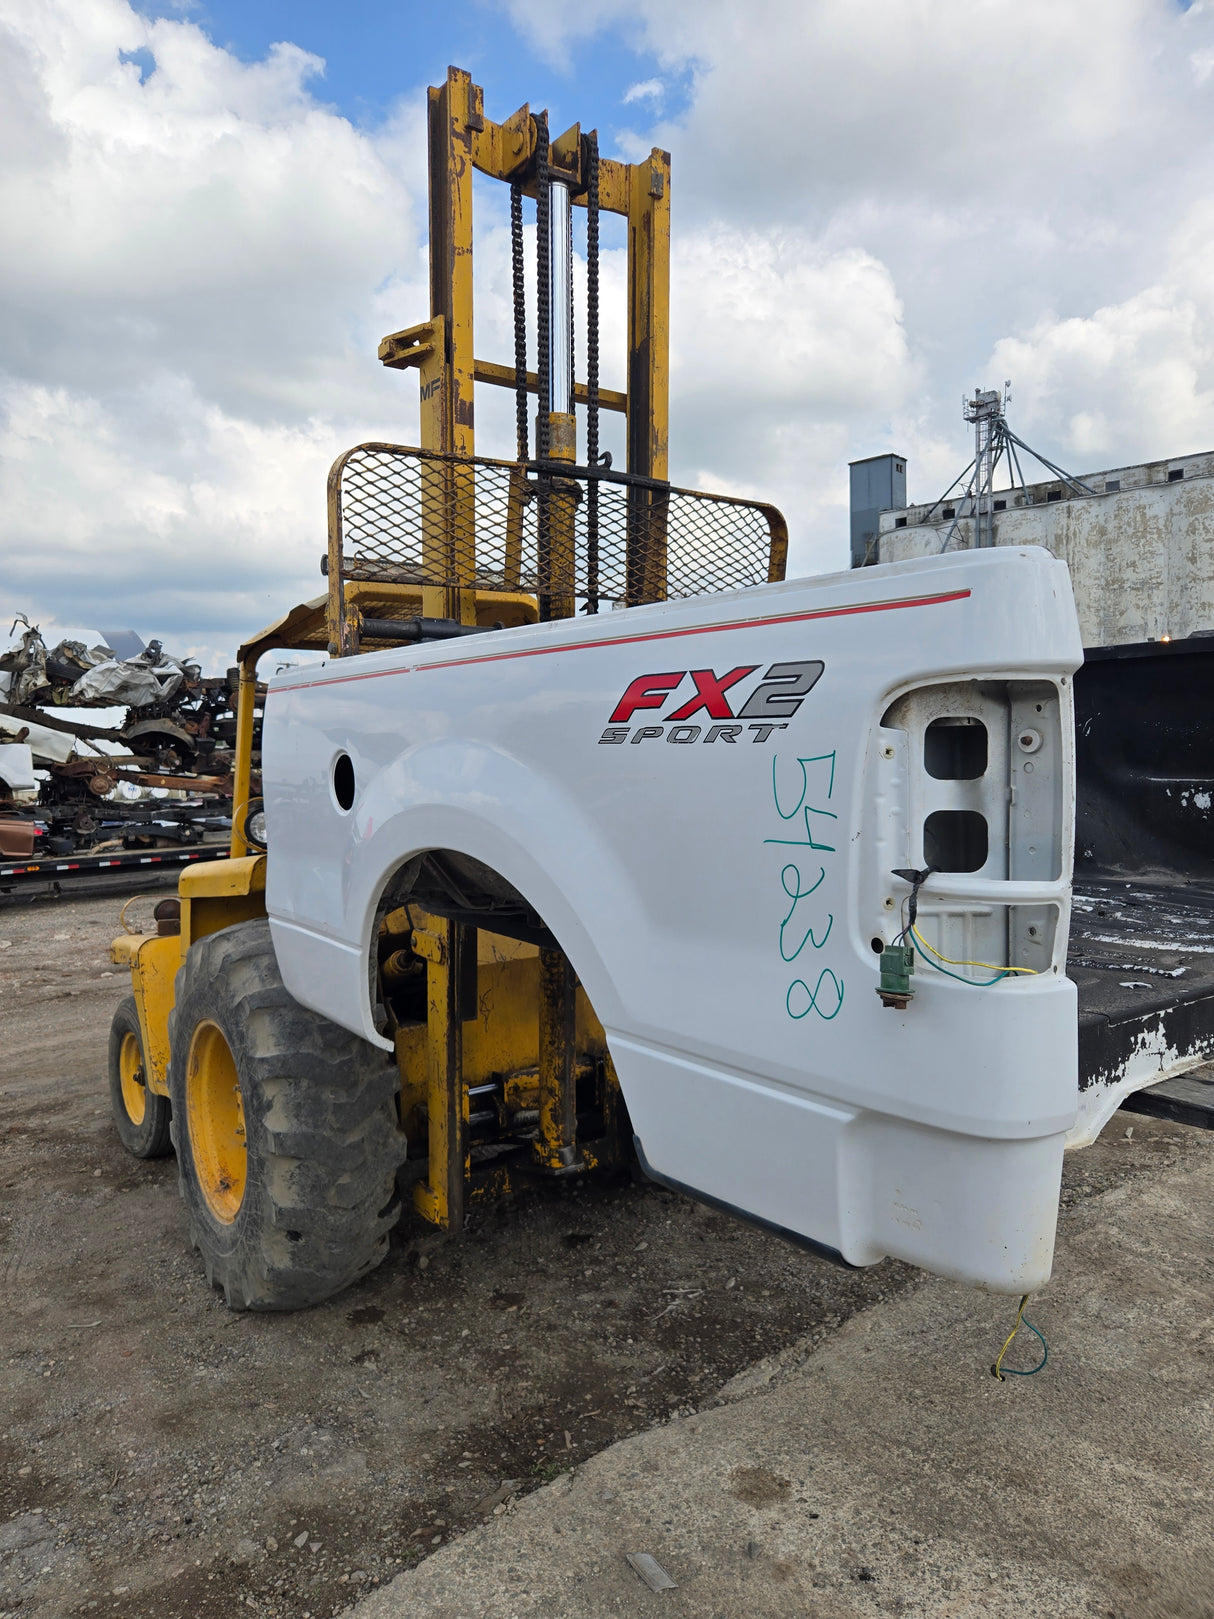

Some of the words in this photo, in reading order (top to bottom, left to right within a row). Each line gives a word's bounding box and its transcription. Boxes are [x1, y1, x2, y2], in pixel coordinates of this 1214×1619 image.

[420, 376, 441, 403] MF
[608, 660, 825, 723] FX2
[598, 723, 789, 744] SPORT
[763, 750, 844, 1019] 54238
